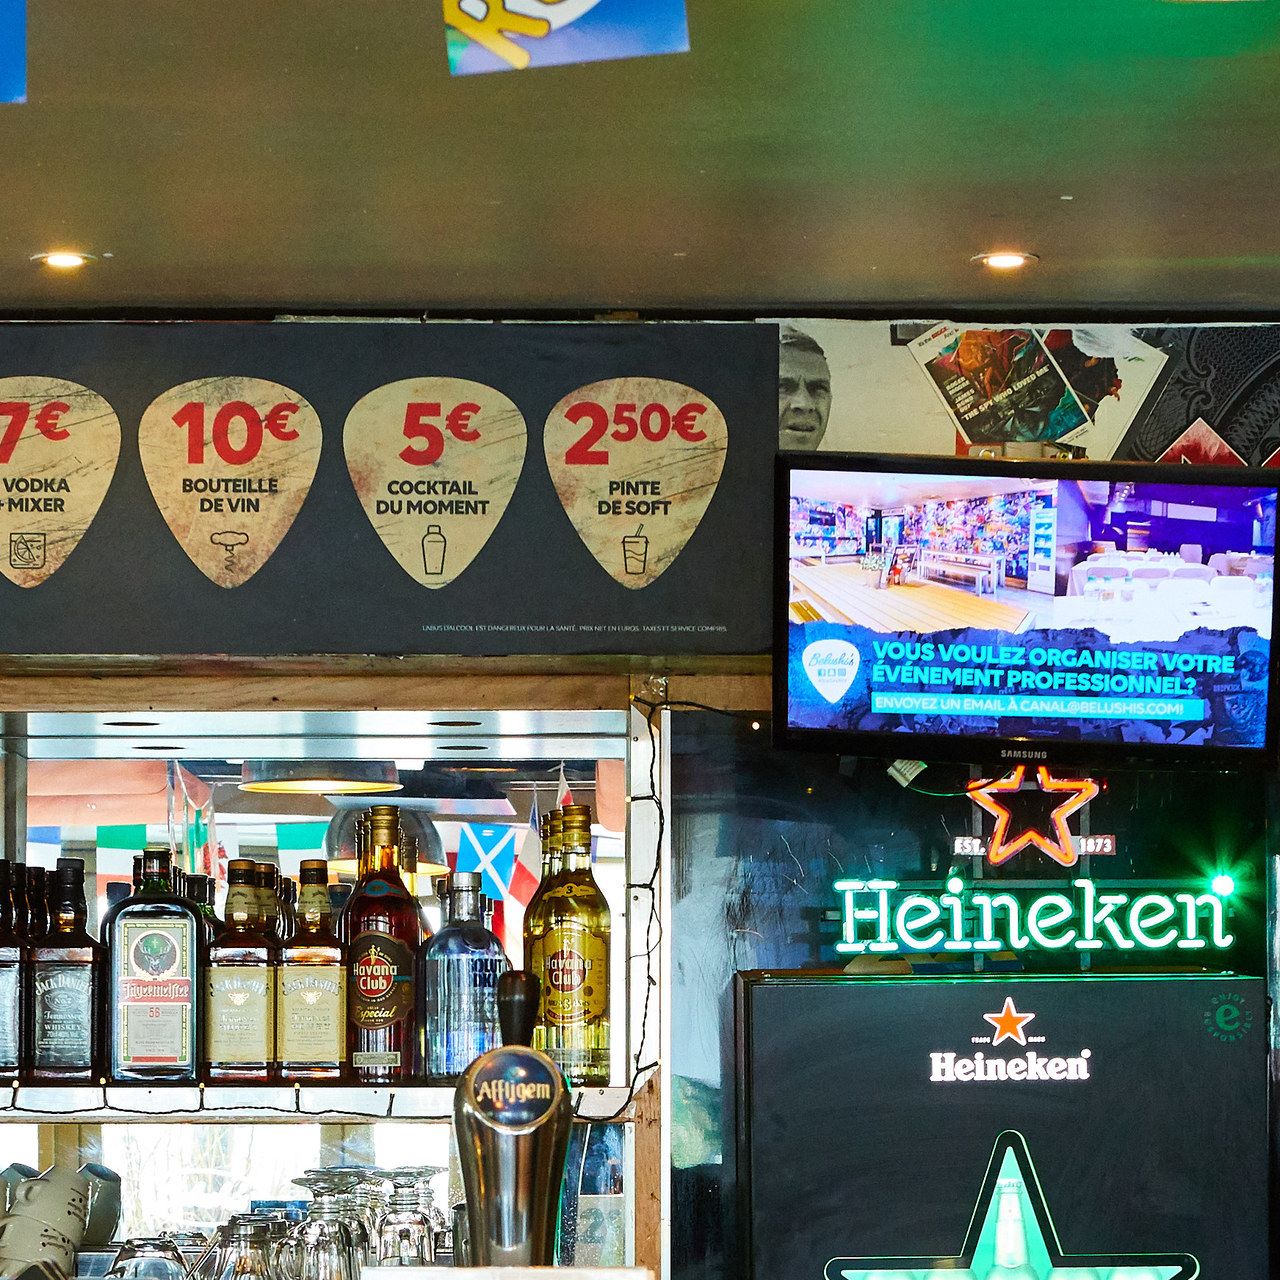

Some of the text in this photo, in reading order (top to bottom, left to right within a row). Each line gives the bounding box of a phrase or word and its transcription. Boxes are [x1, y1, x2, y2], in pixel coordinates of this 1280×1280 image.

[172, 401, 300, 465] 10€
[398, 402, 482, 467] 5€
[2, 477, 71, 493] VODKA
[182, 477, 279, 494] BOUTEILLE
[387, 480, 479, 496] COCKTAIL
[609, 480, 661, 496] PINTE
[7, 497, 65, 513] MIXER
[199, 497, 260, 514] DE VIN
[376, 499, 490, 515] DU MOMENT
[597, 500, 672, 516] DE SOFT
[873, 641, 1236, 674] VOUS VOULEZ ORGANISER VOTRE
[872, 661, 1197, 696] ÉVÉNEMENT PROFESSIONNEL?
[875, 697, 938, 710] ENVOYEZ
[941, 699, 961, 711] UN
[964, 699, 1005, 712] EMAIL
[1020, 700, 1184, 715] CANAL@BELUSHIS.COM!
[1000, 749, 1048, 760] SAMSUNG
[954, 836, 1113, 855] EST. 1873
[834, 877, 1236, 952] Heineken
[353, 964, 398, 977] Havana
[546, 955, 592, 970] Havana
[360, 976, 387, 990] Club
[552, 970, 580, 985] Club
[930, 1048, 1091, 1082] Heineken
[476, 1078, 551, 1104] Affligem
